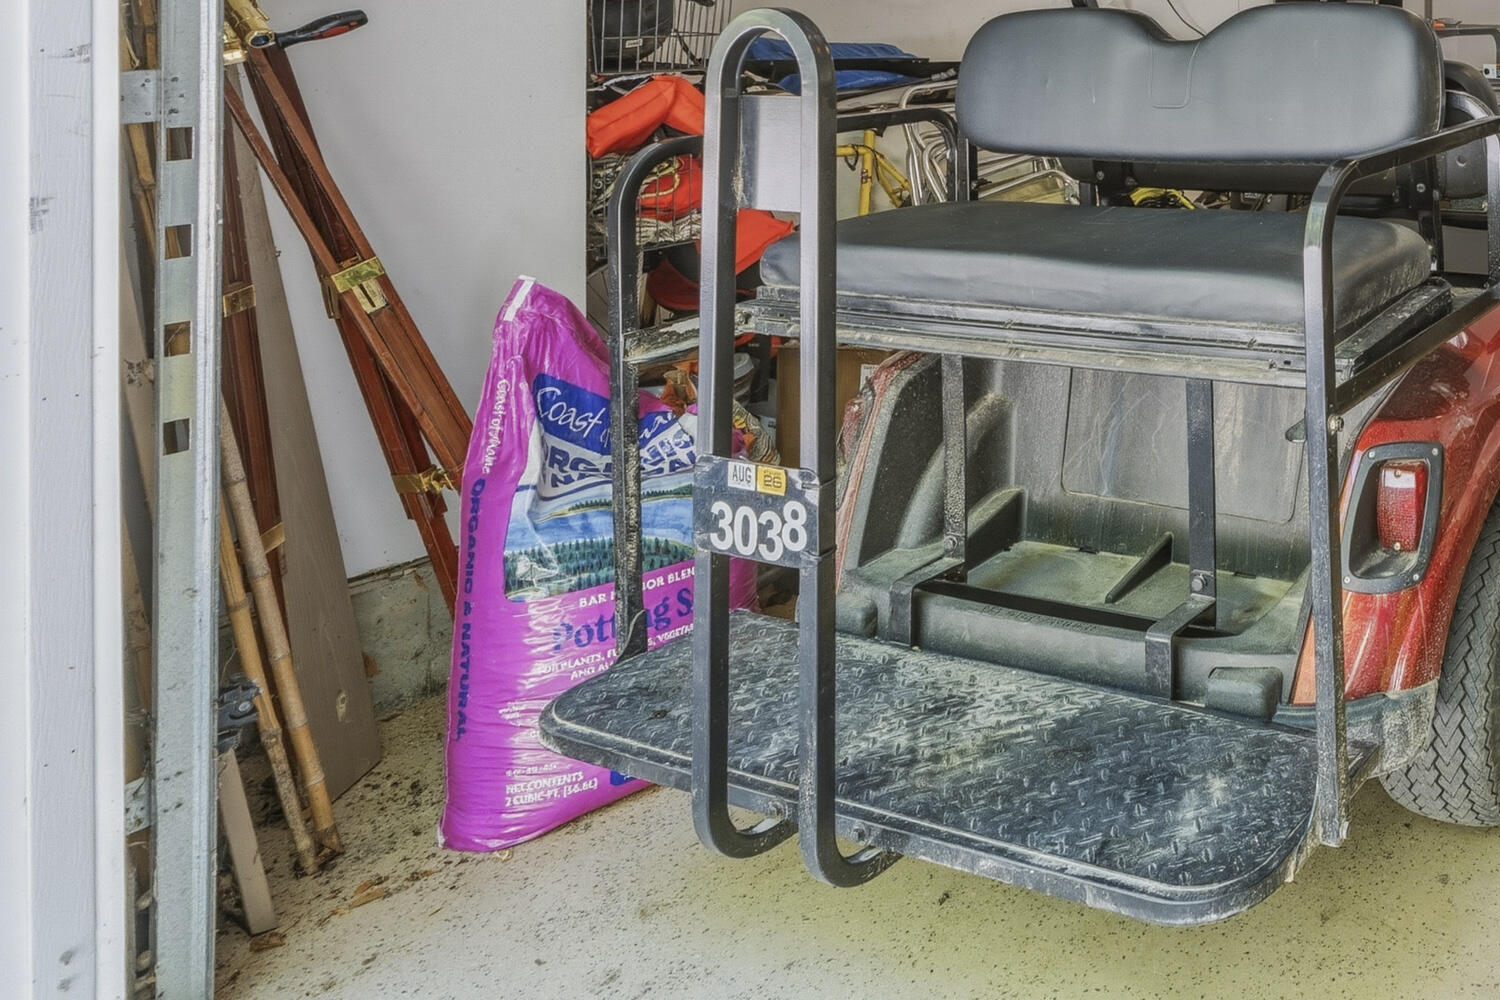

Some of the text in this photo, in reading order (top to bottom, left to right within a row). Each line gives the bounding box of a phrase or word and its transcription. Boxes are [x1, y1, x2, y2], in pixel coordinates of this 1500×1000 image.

[537, 386, 607, 440] Coast
[732, 465, 752, 484] AUG
[710, 501, 808, 562] 3038
